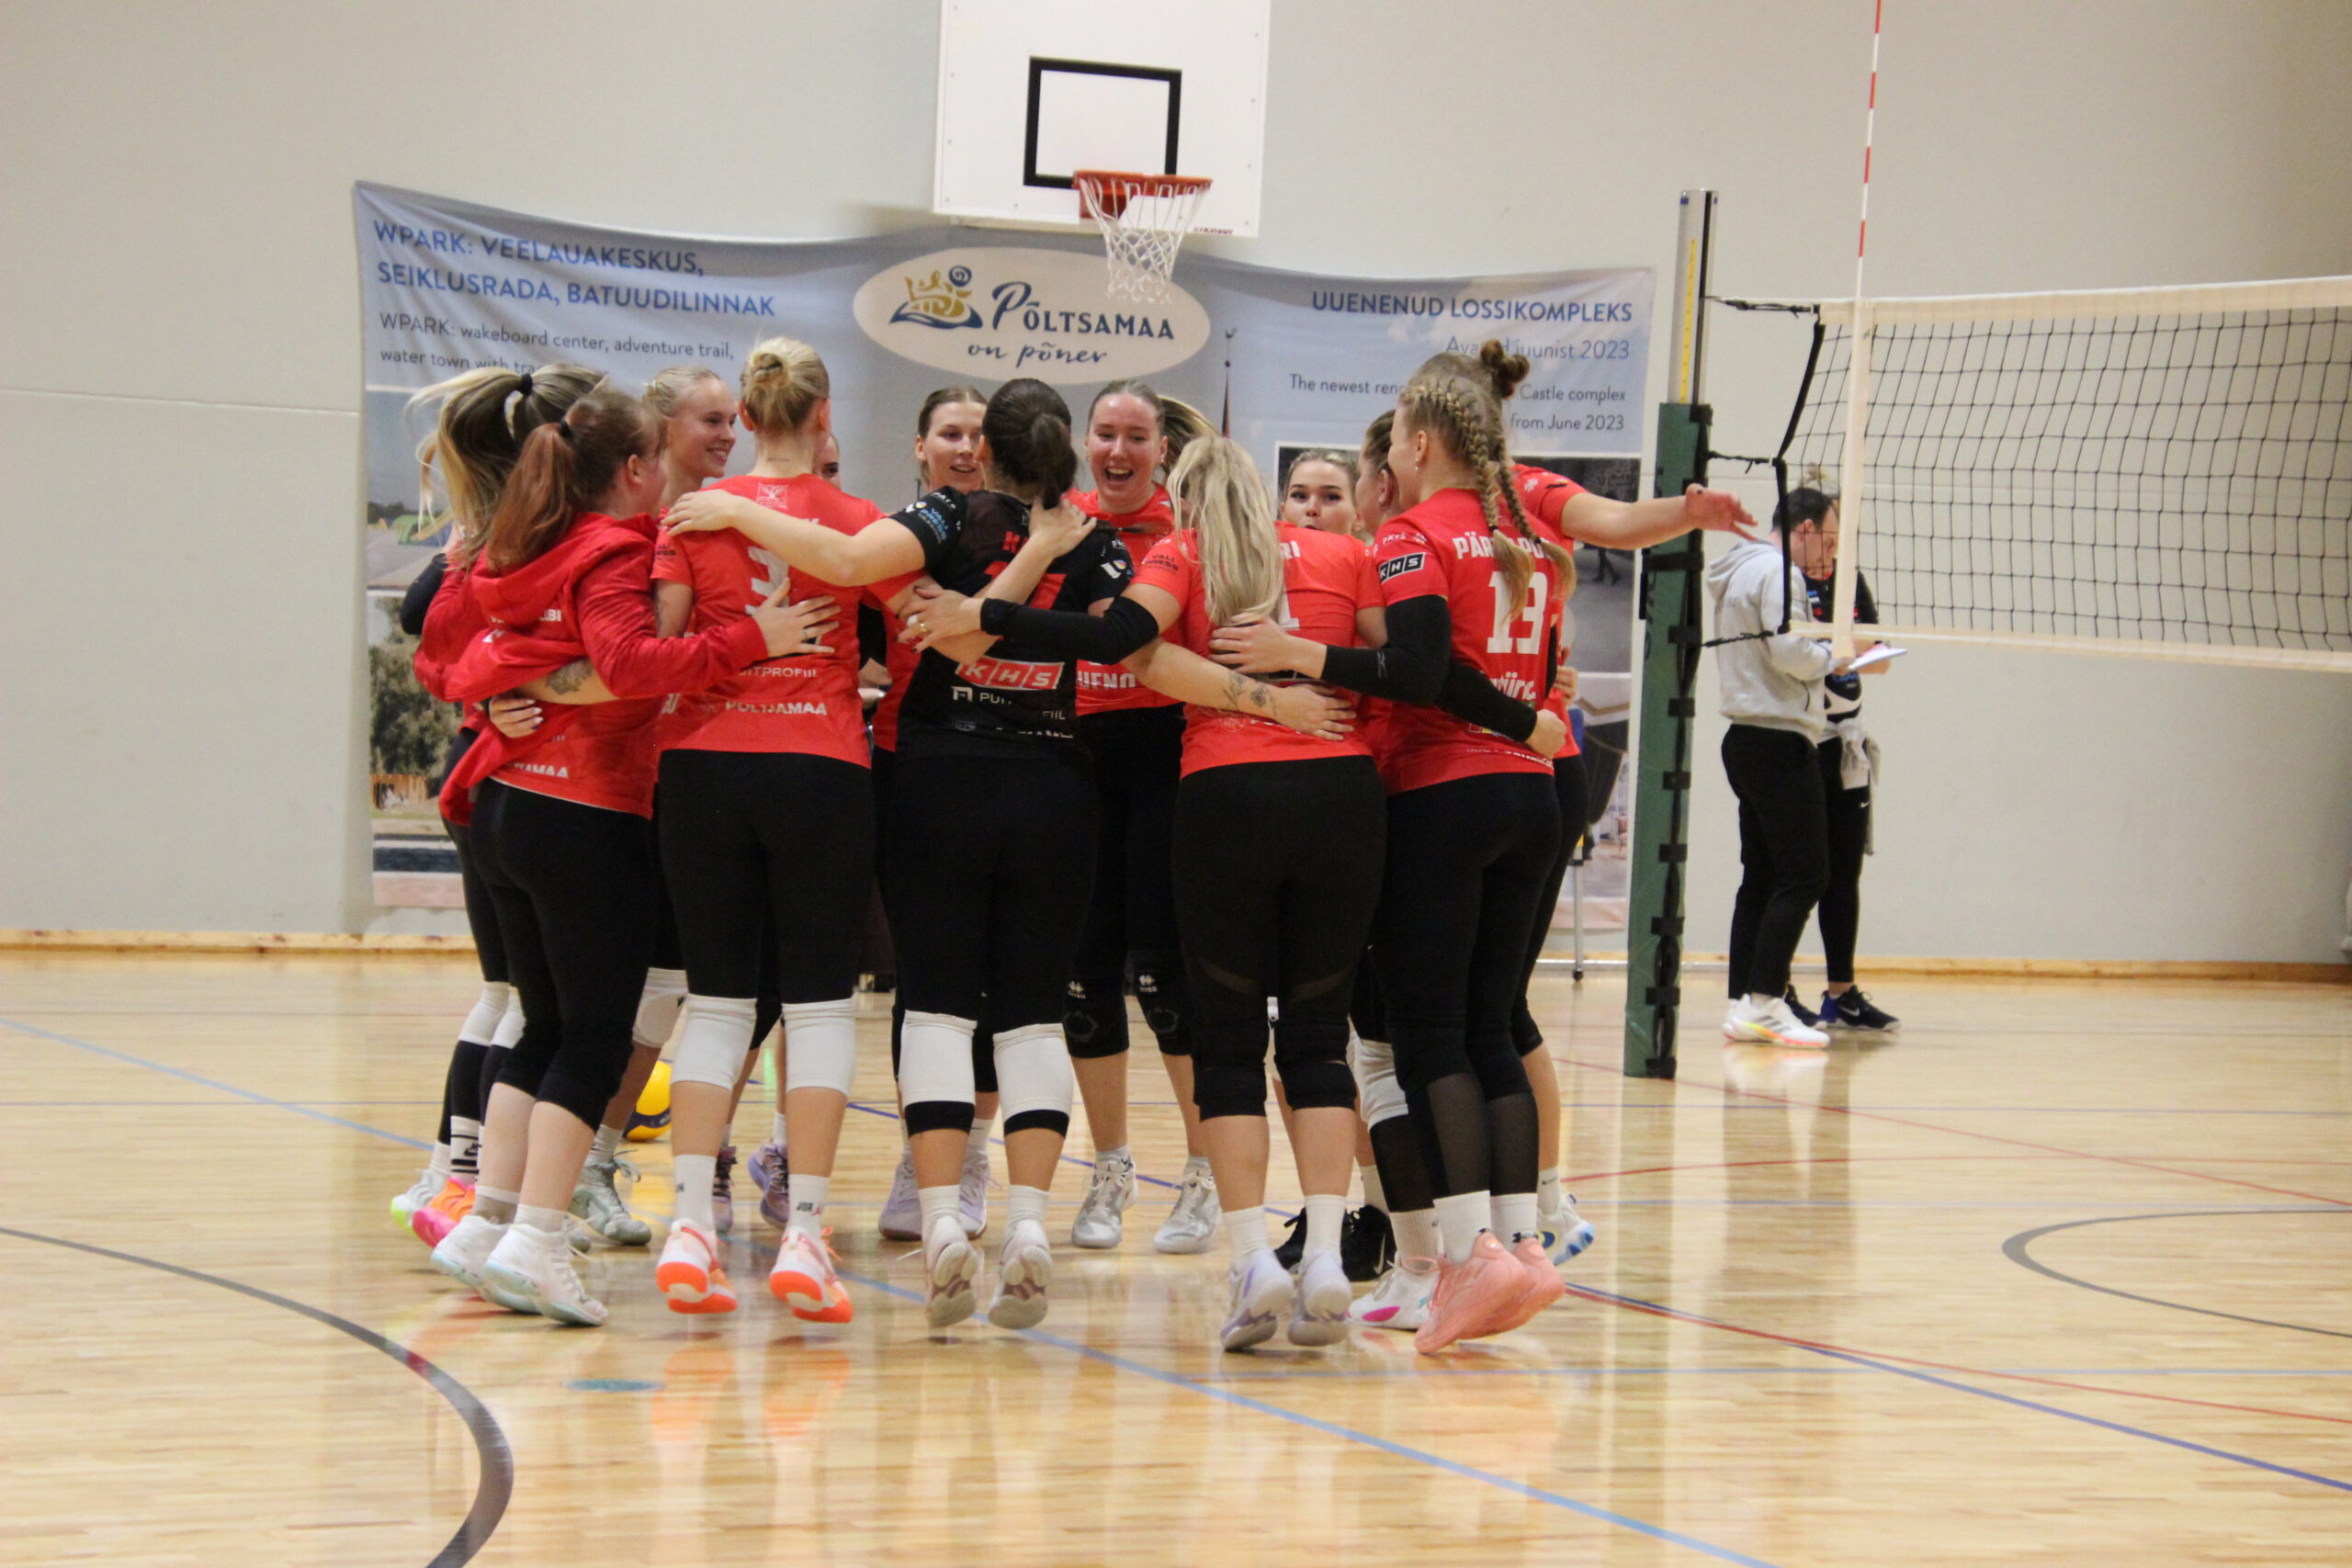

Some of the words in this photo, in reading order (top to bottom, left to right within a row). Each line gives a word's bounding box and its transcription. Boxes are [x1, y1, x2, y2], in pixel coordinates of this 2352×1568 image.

[374, 220, 473, 255] WPARK:
[481, 236, 704, 276] VEELAUAKESKUS,
[378, 262, 560, 306] SEIKLUSRADA,
[567, 283, 775, 317] BATUUDILINNAK
[1312, 290, 1443, 317] UUENENUD
[1452, 298, 1633, 321] LOSSIKOMPLEKS
[379, 311, 455, 337] WPARK:
[461, 323, 548, 346] wakeboard
[553, 335, 609, 354] center,
[615, 336, 694, 357] adventure
[698, 341, 734, 360] trail,
[380, 350, 424, 366] water
[431, 353, 469, 368] town
[1580, 339, 1630, 359] 2023
[1289, 373, 1316, 391] The
[1320, 380, 1370, 394] newest
[1520, 383, 1564, 401] Castle
[1567, 386, 1626, 406] complex
[1510, 414, 1544, 430] from
[1548, 415, 1581, 430] June
[1586, 415, 1624, 431] 2023
[965, 662, 1053, 687] KHS
